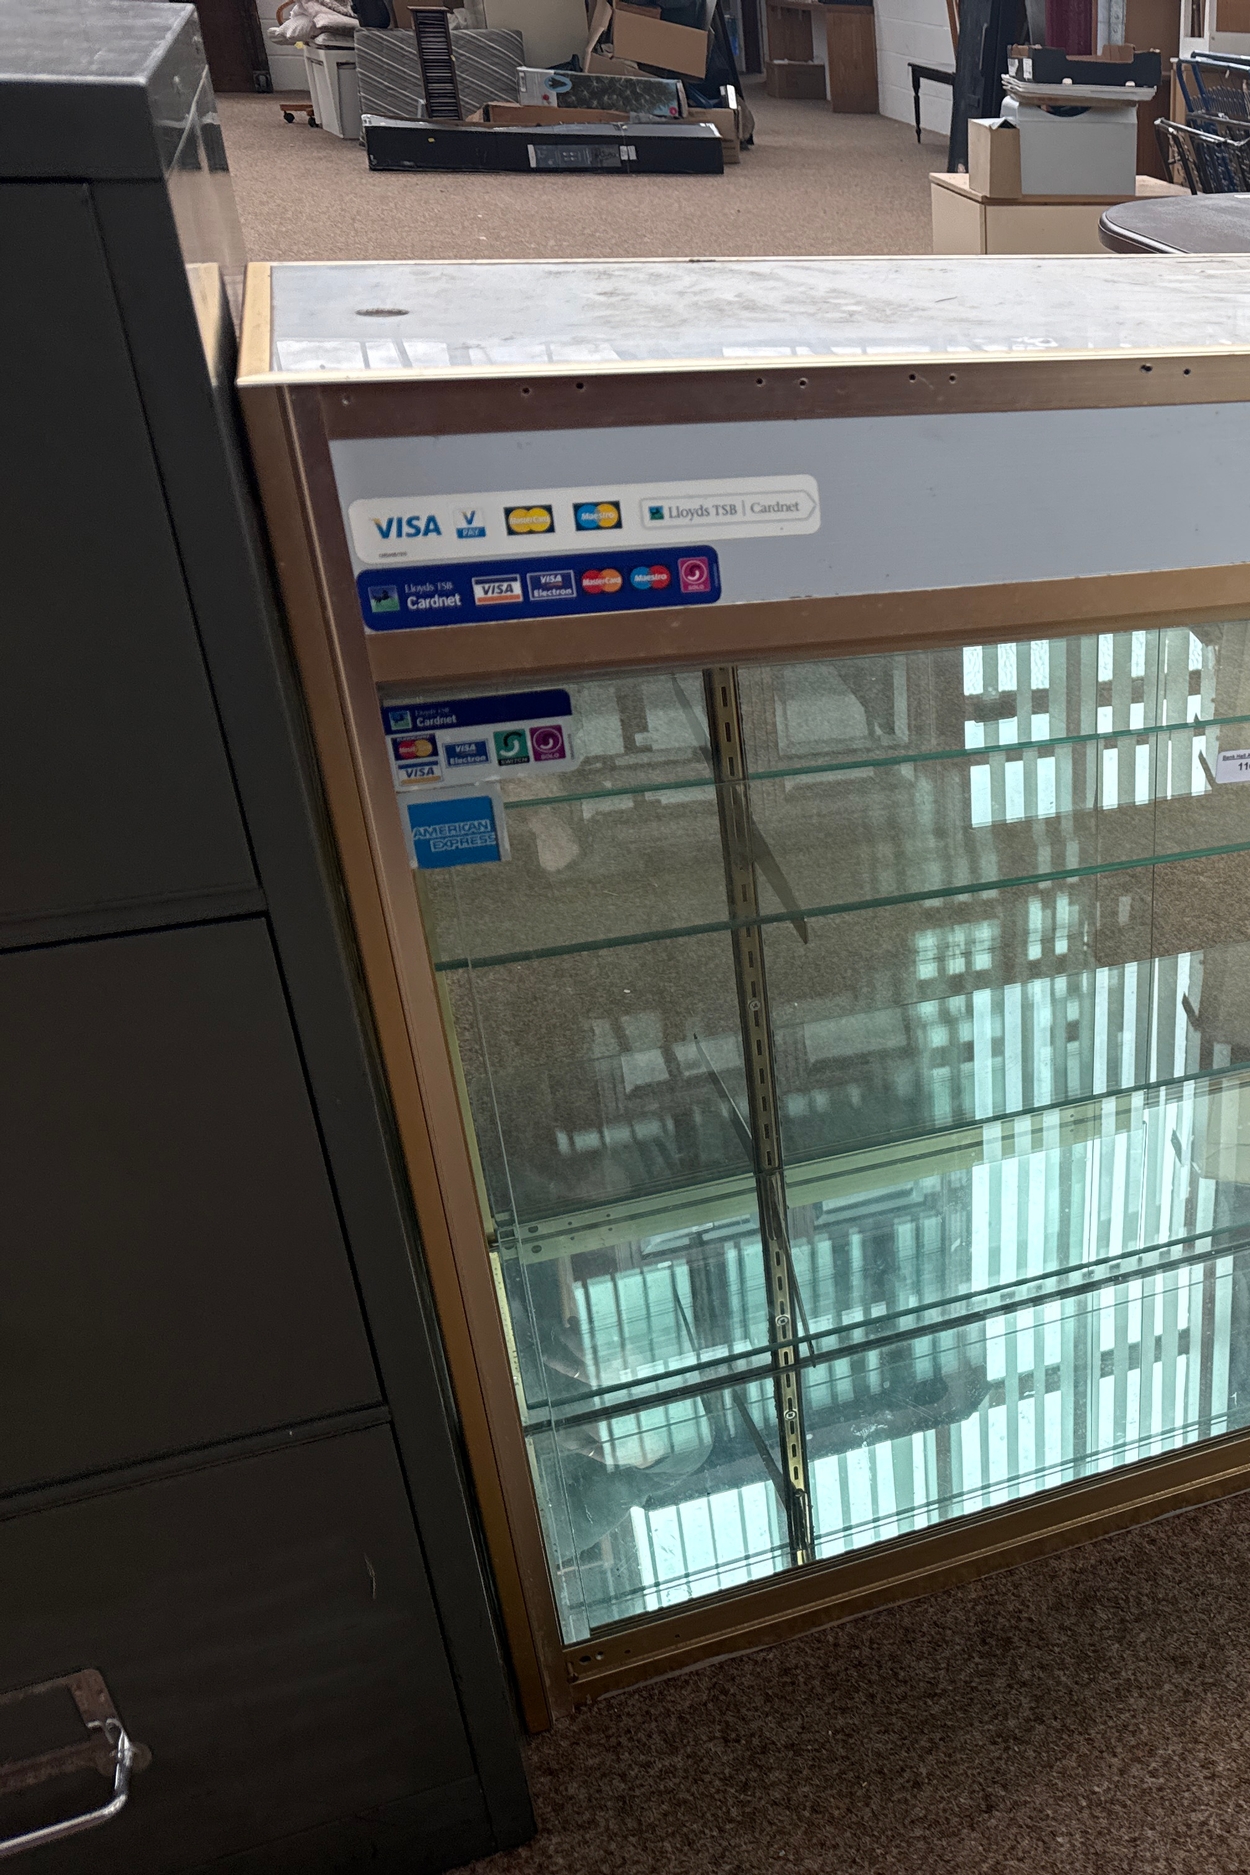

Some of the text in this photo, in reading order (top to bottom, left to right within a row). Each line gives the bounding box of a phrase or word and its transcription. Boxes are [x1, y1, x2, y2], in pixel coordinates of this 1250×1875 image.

[750, 500, 800, 514] Cardnet
[581, 511, 616, 521] Maestro
[668, 504, 738, 522] Lloyds TSB
[509, 515, 551, 525] MasterCard
[371, 514, 443, 540] VISA
[462, 527, 481, 537] PAY
[540, 573, 563, 584] VISA
[582, 576, 622, 587] MasterCard
[633, 573, 668, 583] Maestro
[404, 581, 453, 594] Lloyds TSB
[481, 583, 514, 596] VISA
[533, 588, 573, 598] Electron
[687, 584, 706, 592] SOLO
[406, 593, 462, 611] Cardnet
[416, 714, 457, 728] Cardnet
[455, 743, 477, 753] VISA
[450, 755, 487, 766] Electron
[500, 757, 529, 765] SWITCH
[540, 752, 560, 760] SOLO
[405, 766, 435, 779] VISA
[412, 819, 491, 841] AMERICAN
[430, 833, 497, 853] EXPRESS
